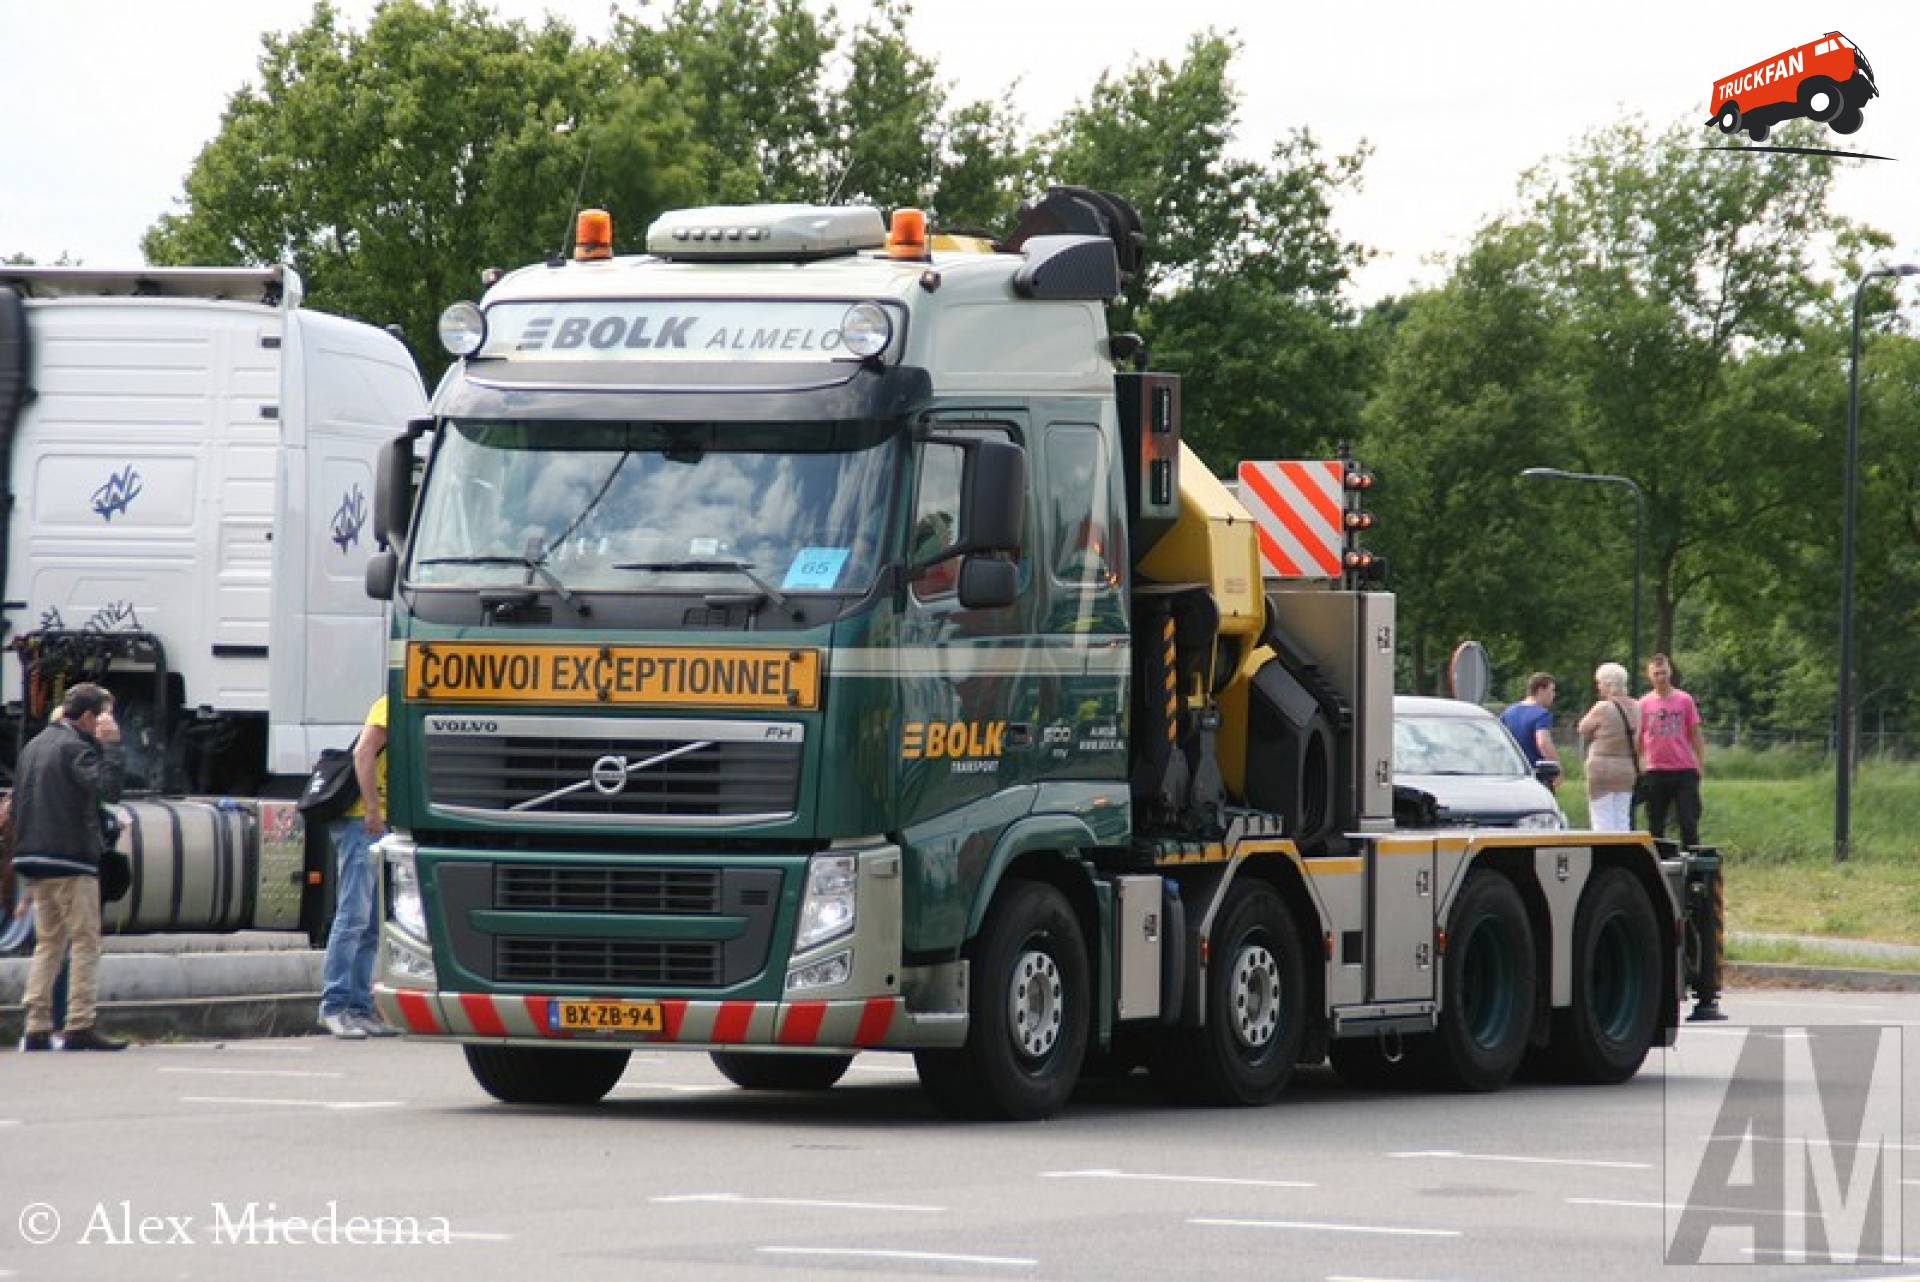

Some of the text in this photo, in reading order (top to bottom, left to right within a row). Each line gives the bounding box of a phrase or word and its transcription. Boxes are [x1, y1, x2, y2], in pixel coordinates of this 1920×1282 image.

[552, 317, 842, 350] BOLK ALMELO
[421, 653, 797, 695] CONVOI EXCEPTIONNEL
[432, 719, 498, 733] VOLVO
[765, 726, 793, 739] FH
[926, 719, 1007, 758] BOLK
[565, 1005, 654, 1026] BX-ZB-94
